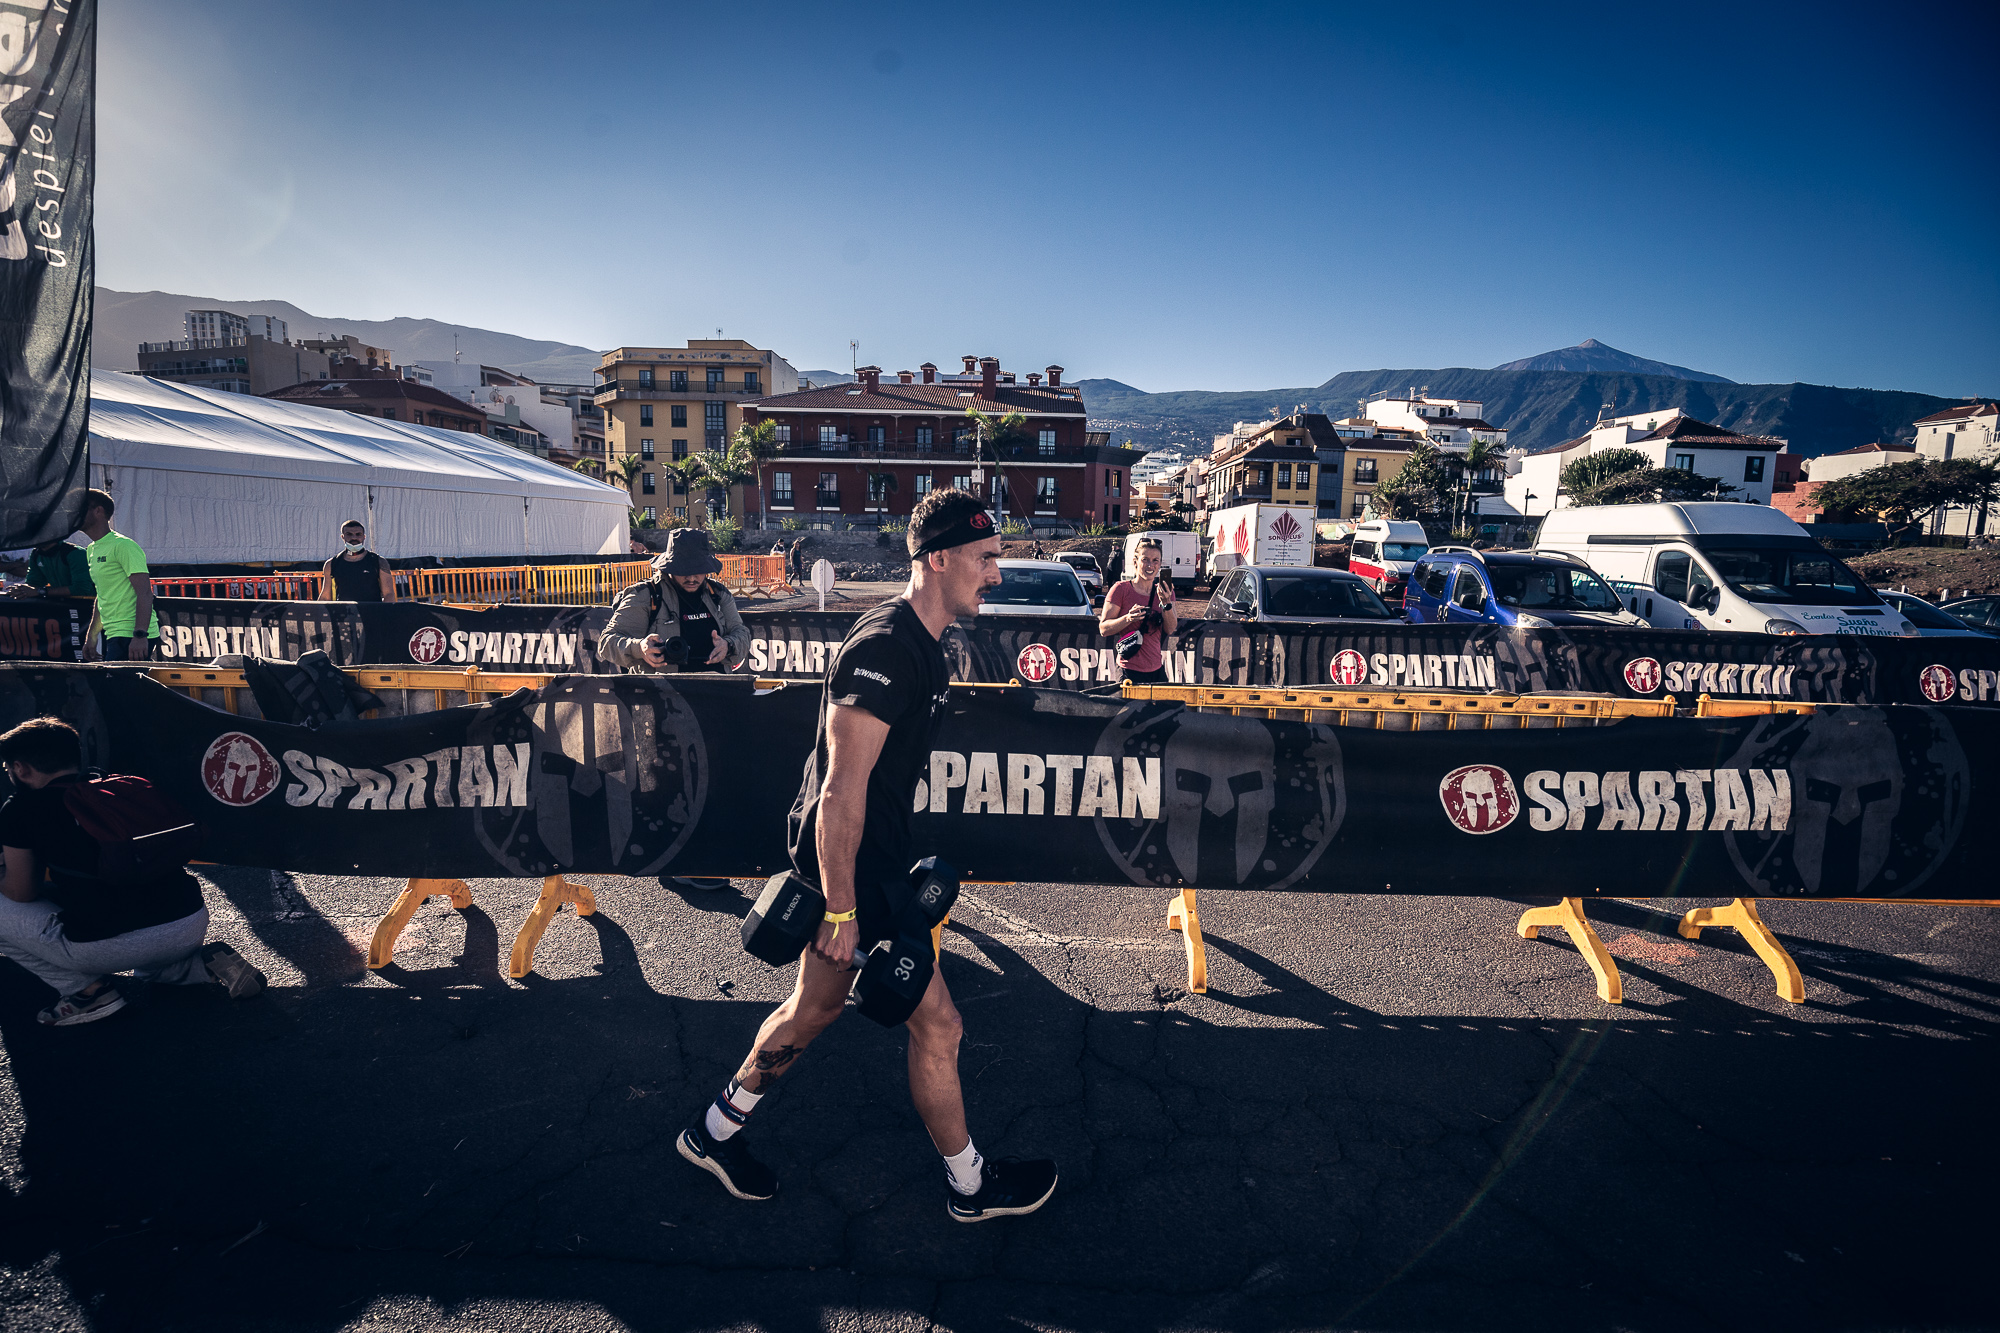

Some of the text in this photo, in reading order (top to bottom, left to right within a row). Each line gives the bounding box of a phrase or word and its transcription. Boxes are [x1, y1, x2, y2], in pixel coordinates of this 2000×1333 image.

[45, 618, 62, 659] 6
[1836, 616, 1878, 627] Sueño
[160, 625, 280, 659] SPARTAN
[449, 630, 577, 665] SPARTAN
[748, 638, 844, 673] SPART
[1370, 653, 1496, 687] SPARTAN
[1664, 661, 1796, 695] SPARTAN
[282, 742, 530, 810] SPARTAN
[1523, 768, 1792, 832] SPARTAN
[782, 893, 802, 921] BLKBOX
[924, 884, 942, 904] 30
[894, 956, 915, 981] 30
